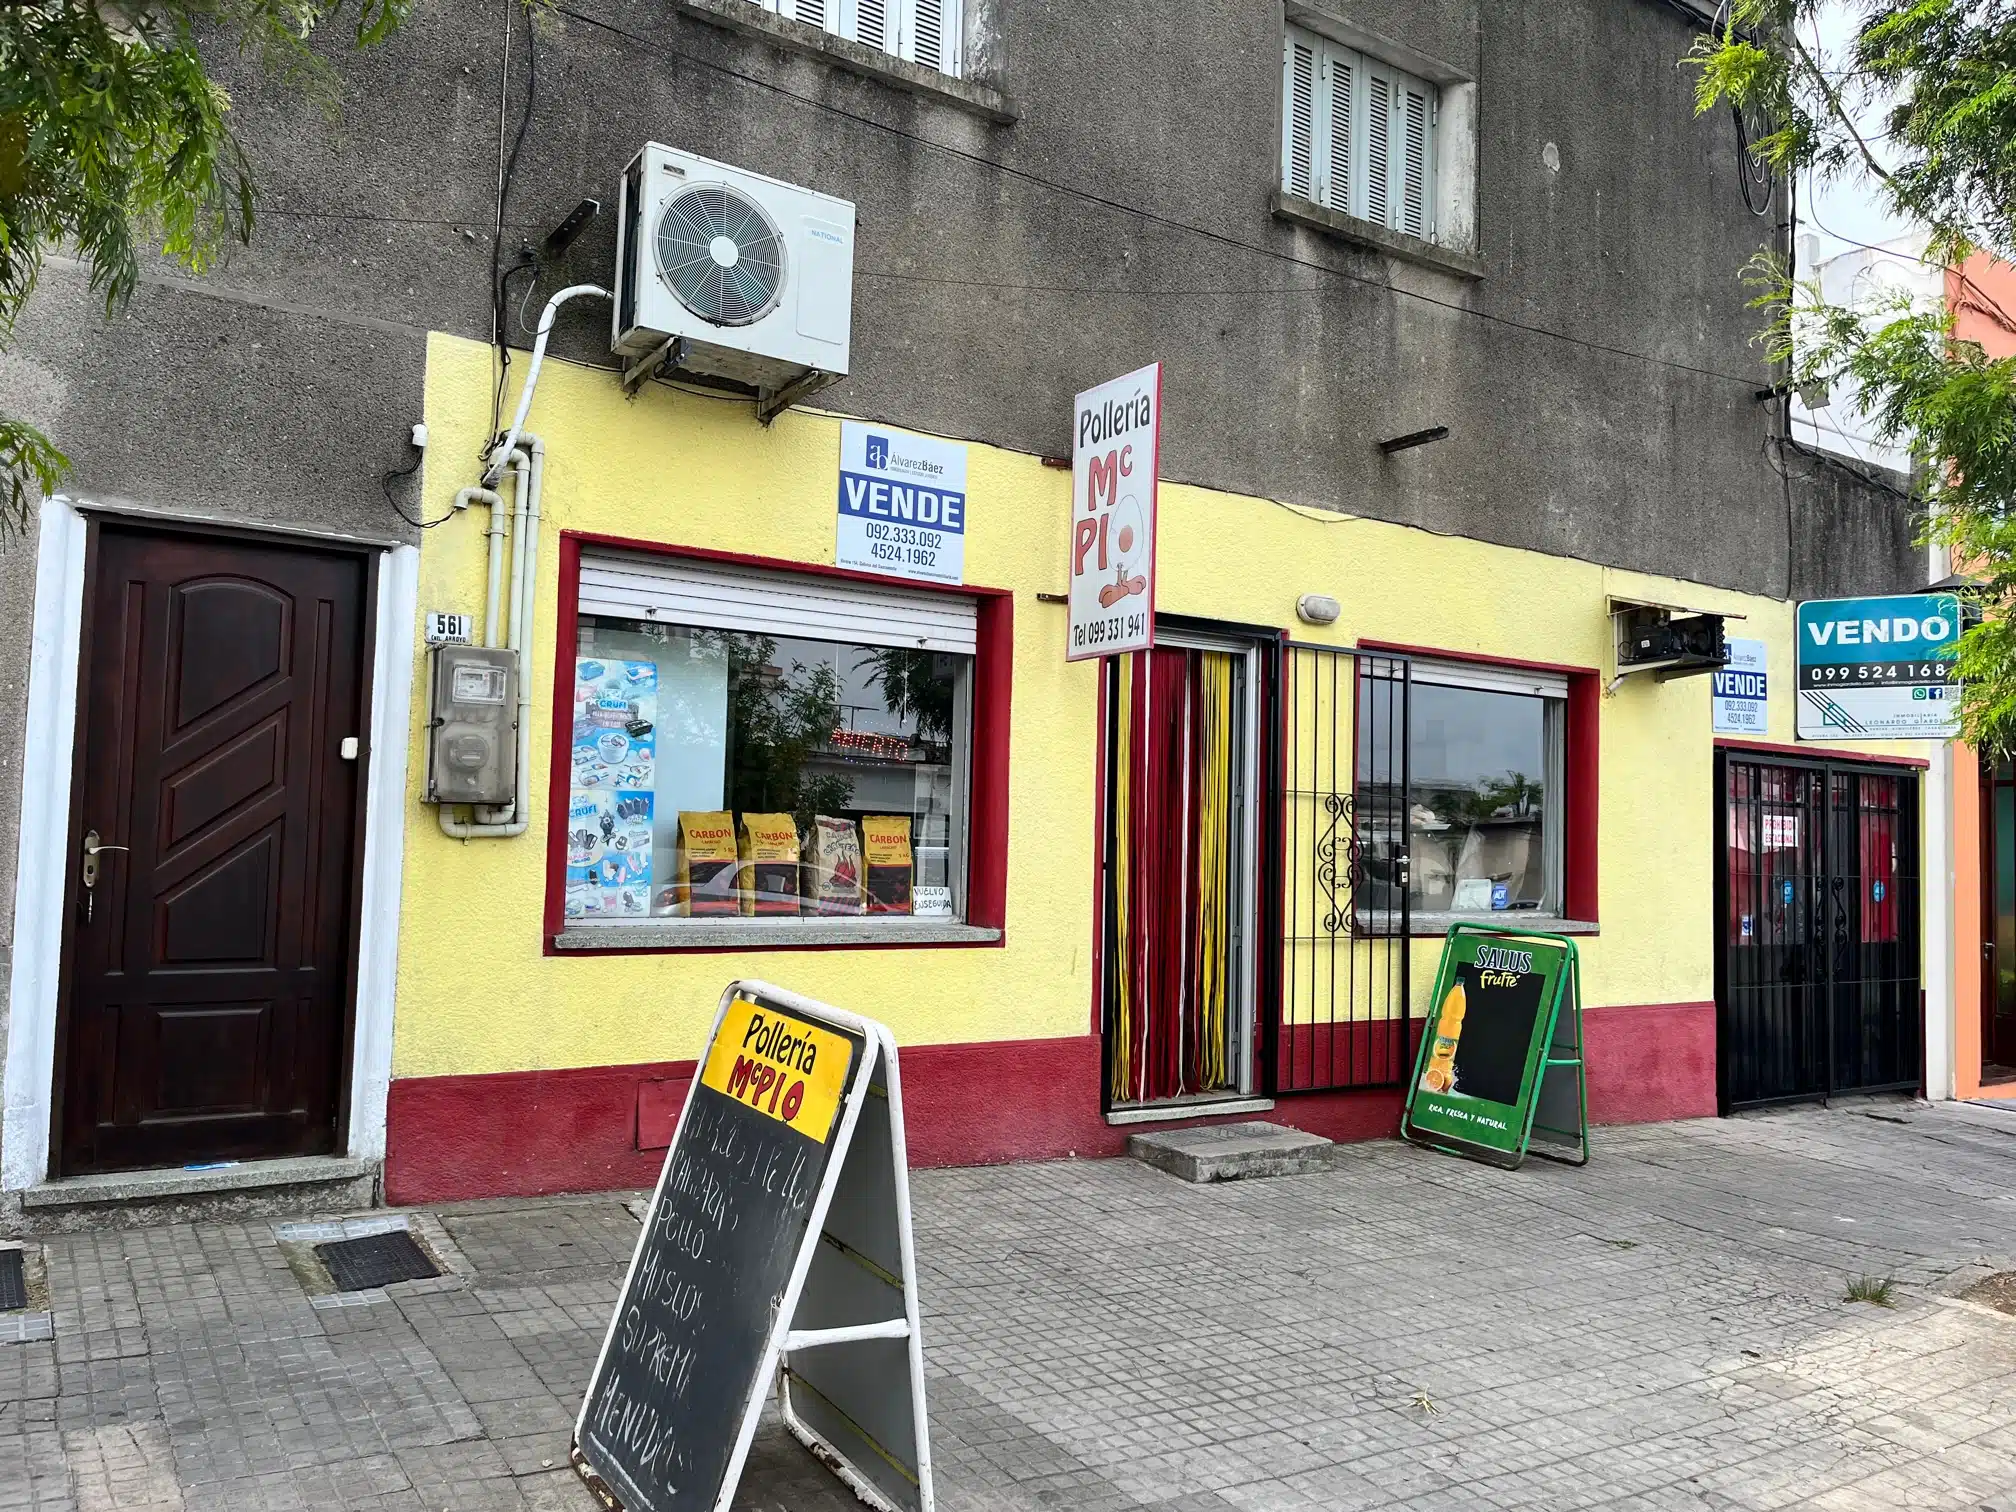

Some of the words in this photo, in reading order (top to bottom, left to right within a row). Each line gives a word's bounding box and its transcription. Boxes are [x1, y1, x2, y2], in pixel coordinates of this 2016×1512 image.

[811, 229, 844, 244] NATIONAL
[1080, 387, 1150, 448] Pollería
[844, 476, 961, 529] VENDE
[866, 522, 942, 550] 092.333.092
[871, 542, 936, 567] 4524.1962
[437, 614, 461, 635] 561
[1073, 623, 1086, 647] Tel
[1088, 619, 1105, 645] 099
[1107, 615, 1124, 641] 331
[1127, 613, 1145, 638] 941
[1807, 616, 1950, 646] VENDO
[1812, 666, 1850, 681] 099
[1858, 665, 1898, 679] 524
[1908, 663, 1947, 677] 168
[1714, 672, 1766, 697] VENDE
[1724, 700, 1758, 713] 092.333.092
[1727, 713, 1756, 725] 4524.1962
[829, 725, 909, 762] ABIERTO
[689, 828, 731, 839] CARBON
[1765, 819, 1795, 831] PROHBID
[754, 831, 793, 842] CARBON
[869, 834, 907, 844] CARBON
[914, 887, 944, 896] VUELVO
[1492, 889, 1506, 899] ADT
[914, 899, 952, 910] ENSEGUIDA
[1474, 944, 1533, 974] SALUS
[742, 1013, 817, 1075] Pollería
[1446, 1107, 1468, 1121] FRESCA
[1470, 1114, 1475, 1122] Y
[1476, 1115, 1508, 1131] NATURAL
[655, 1197, 704, 1259] POLLO
